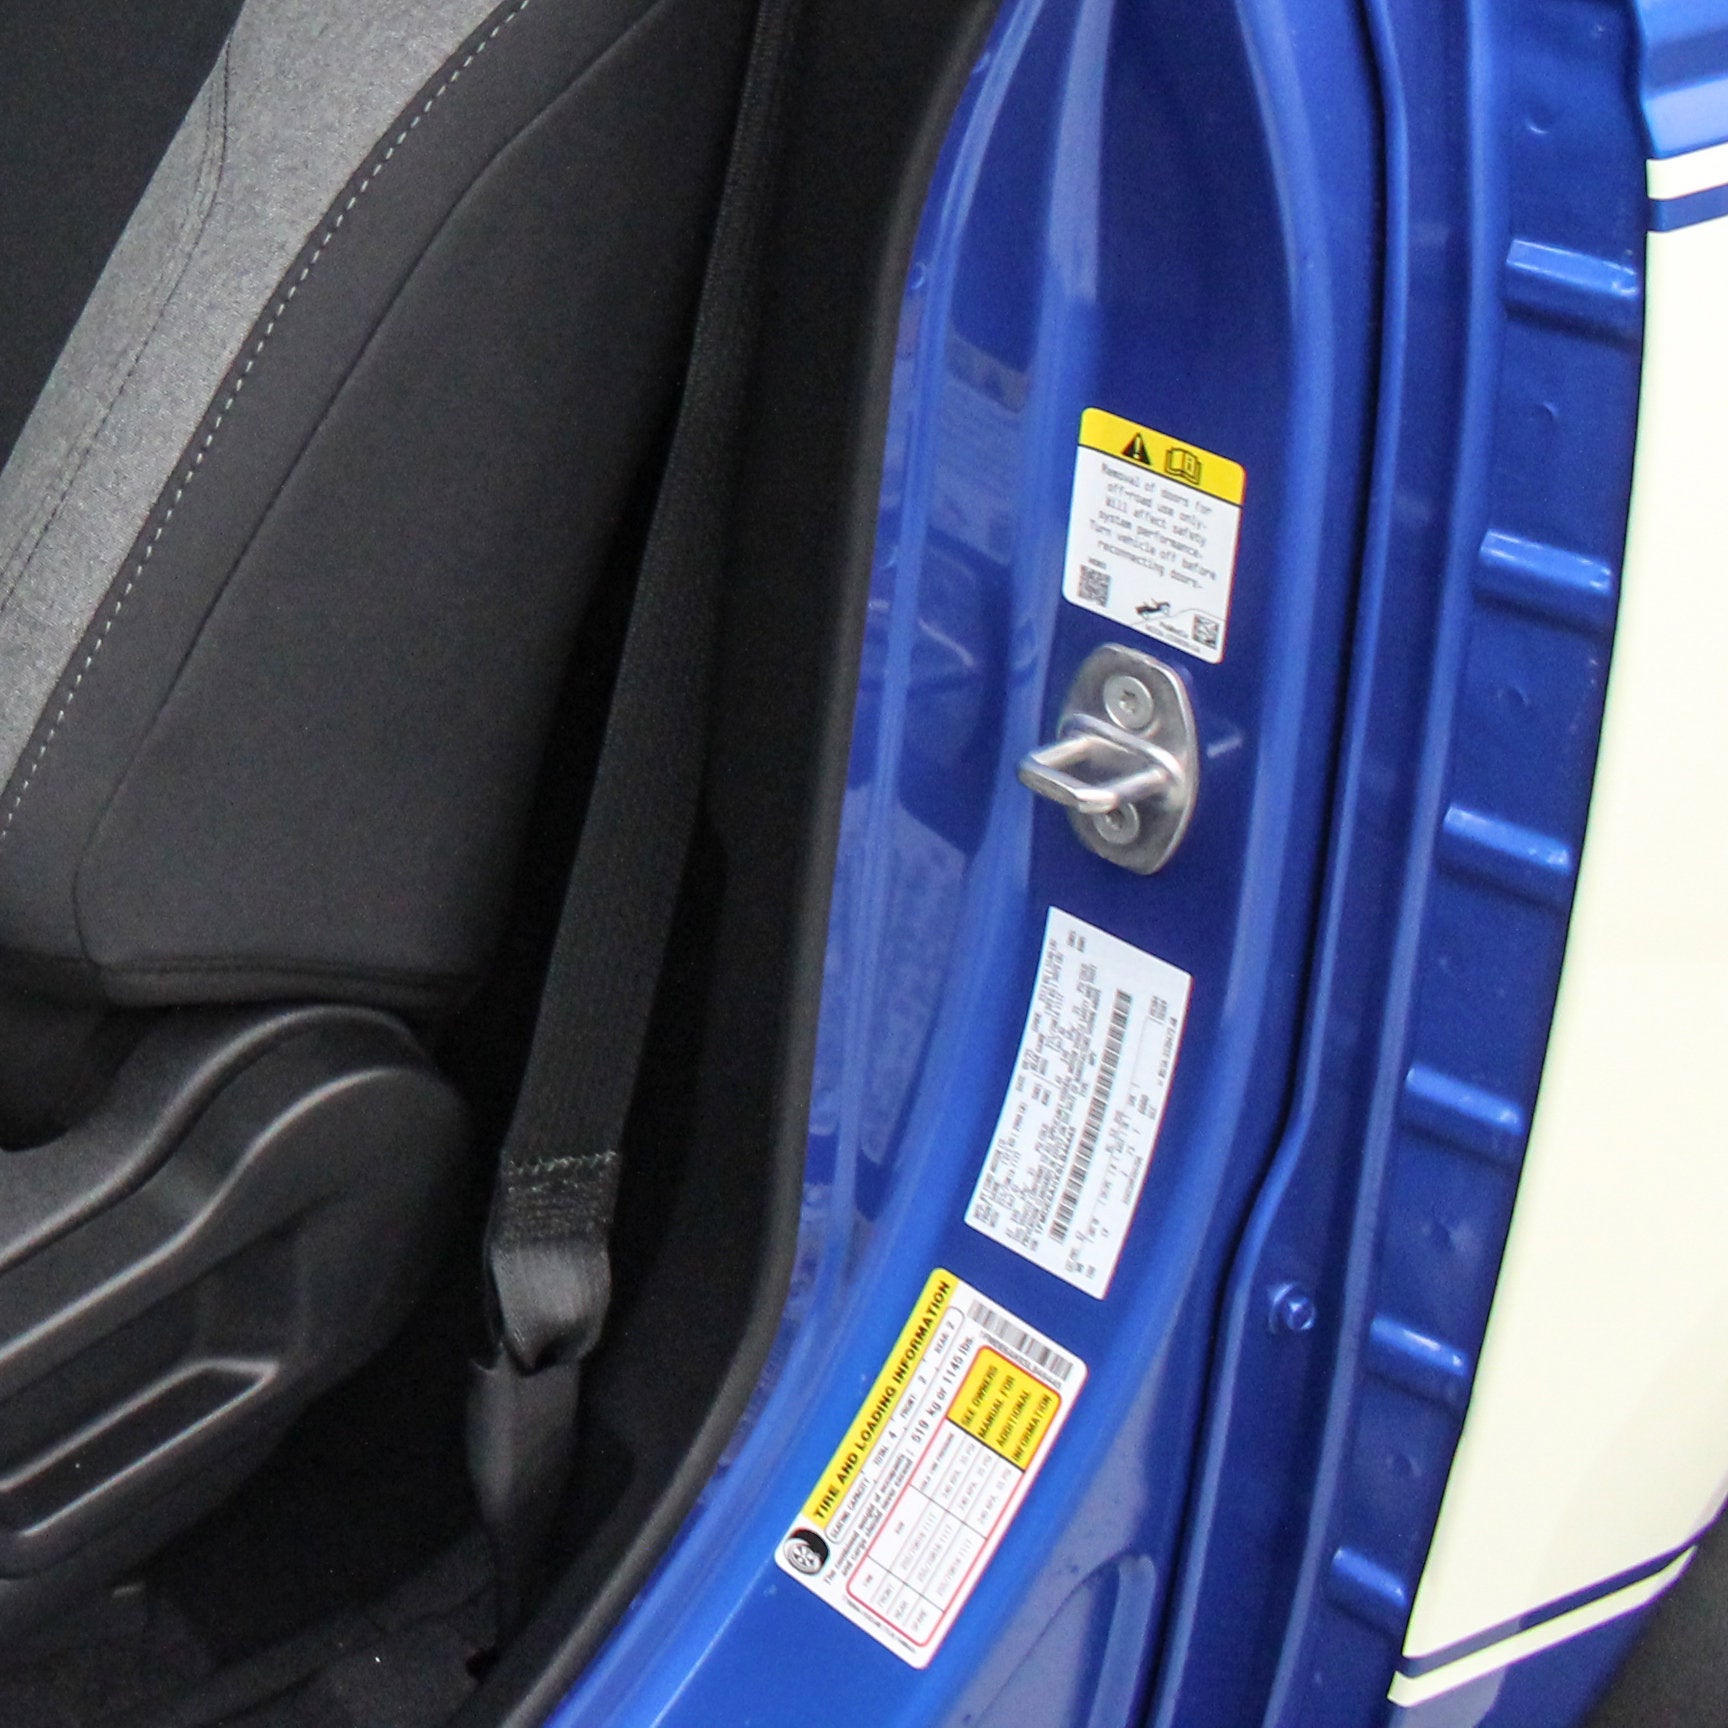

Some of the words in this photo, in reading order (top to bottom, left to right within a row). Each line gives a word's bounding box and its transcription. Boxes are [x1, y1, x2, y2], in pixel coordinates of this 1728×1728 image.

[812, 1482, 841, 1522] TIRE
[833, 1448, 860, 1485] AND
[850, 1381, 897, 1452] LOADING
[889, 1277, 952, 1385] INFORMATION
[924, 1398, 942, 1418] kg
